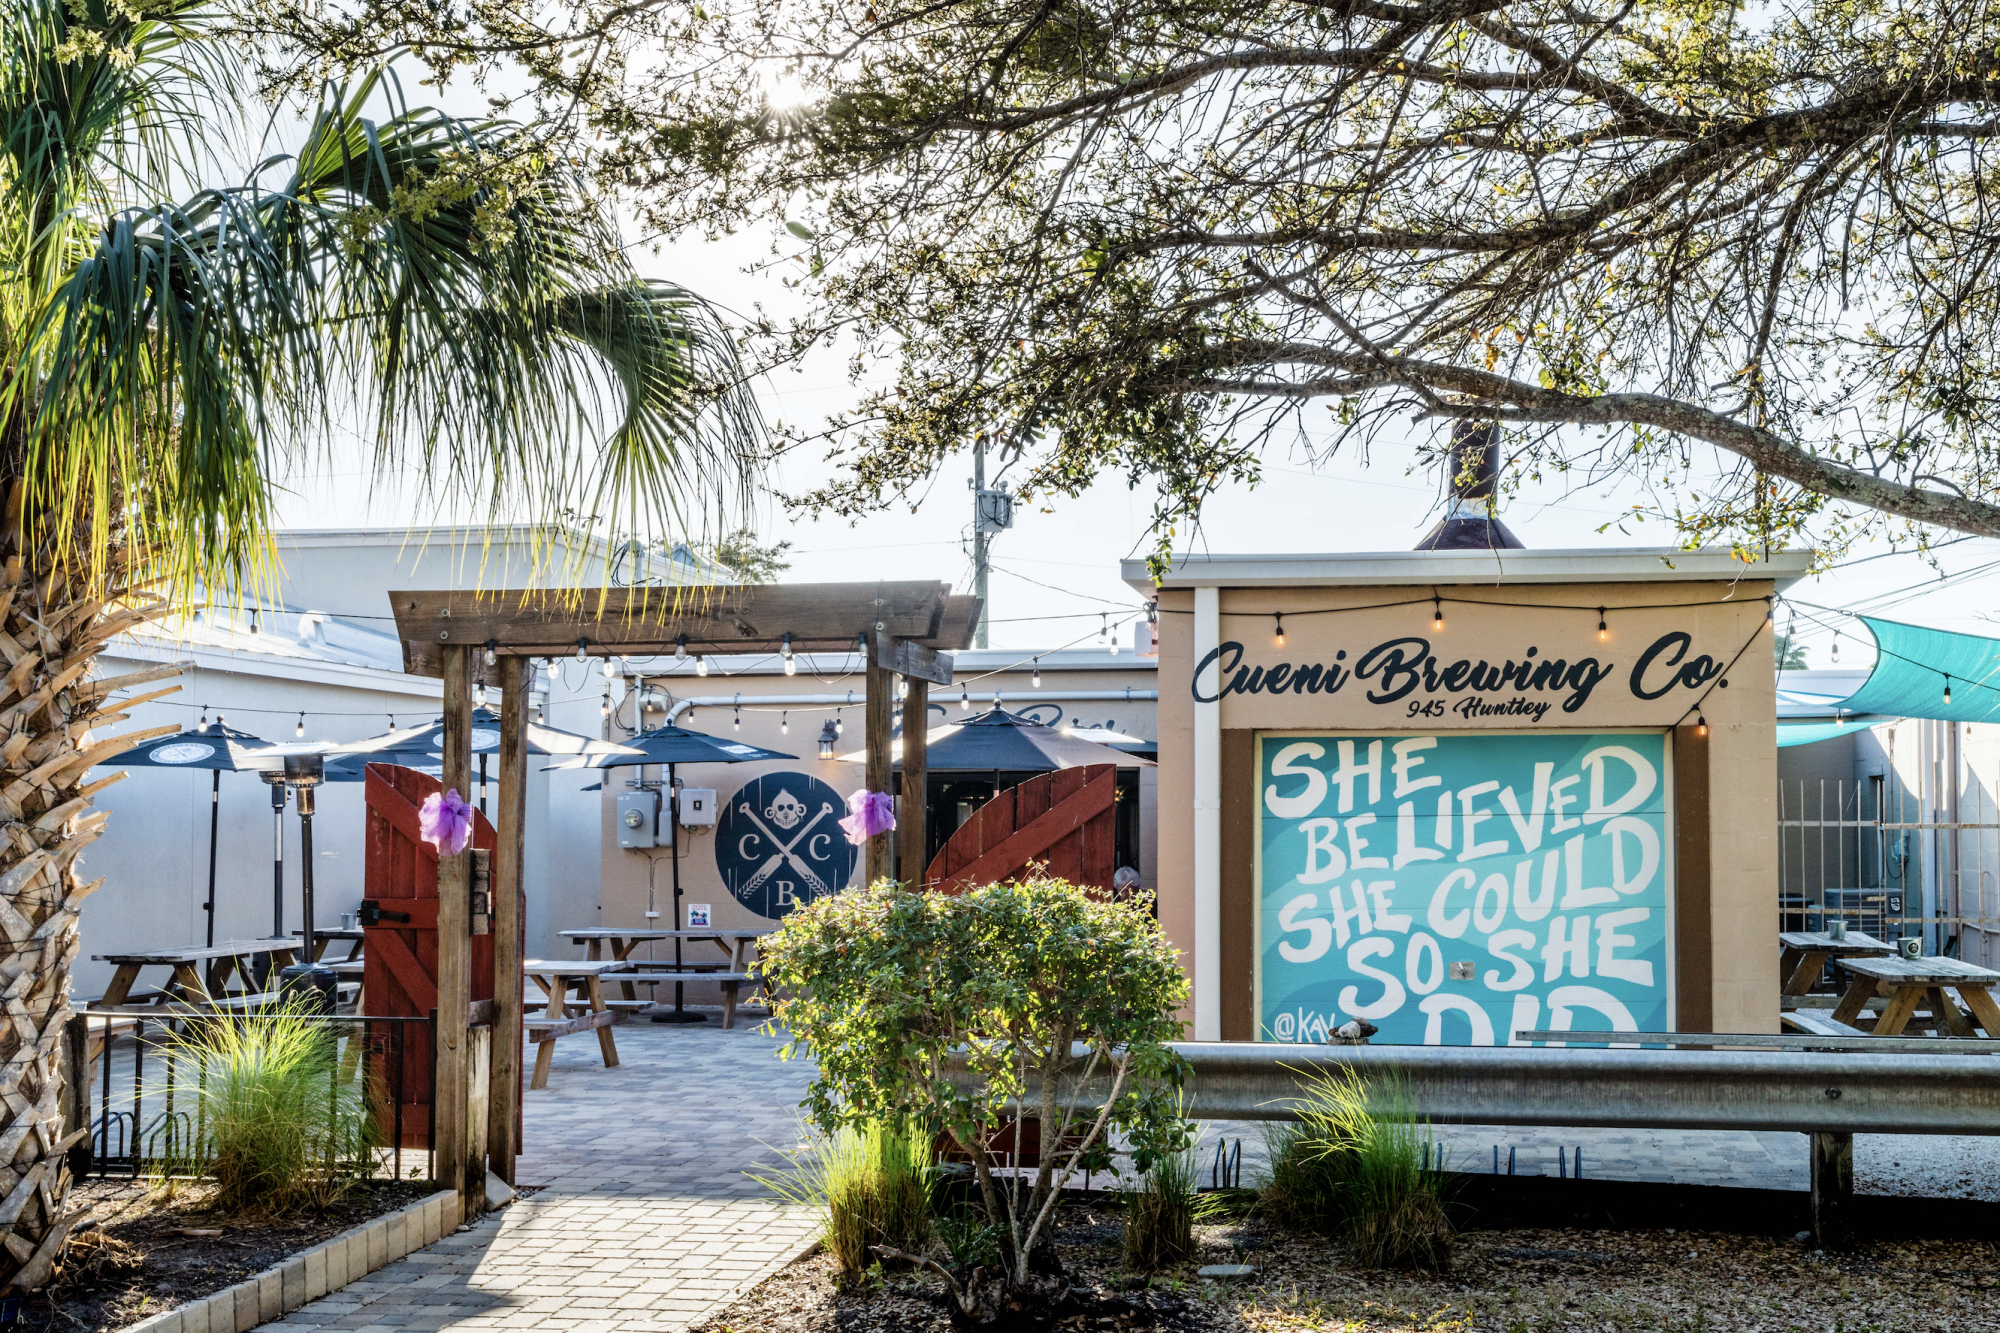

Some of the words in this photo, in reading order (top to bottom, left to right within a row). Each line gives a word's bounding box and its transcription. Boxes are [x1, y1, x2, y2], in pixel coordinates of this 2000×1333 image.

[1192, 641, 1351, 703] Cueni
[1355, 637, 1613, 713] Brewing
[1630, 631, 1728, 700] Co.
[1406, 699, 1445, 718] 945
[1453, 696, 1551, 722] Huntley
[1264, 736, 1442, 819] SHE
[1296, 745, 1657, 885] BELIEVED
[738, 834, 761, 861] C
[808, 834, 832, 861] C
[775, 880, 796, 906] B
[1278, 879, 1413, 963] SHE
[1427, 816, 1660, 939] COULD
[1338, 931, 1445, 1019] SO
[1483, 907, 1655, 992] SHE
